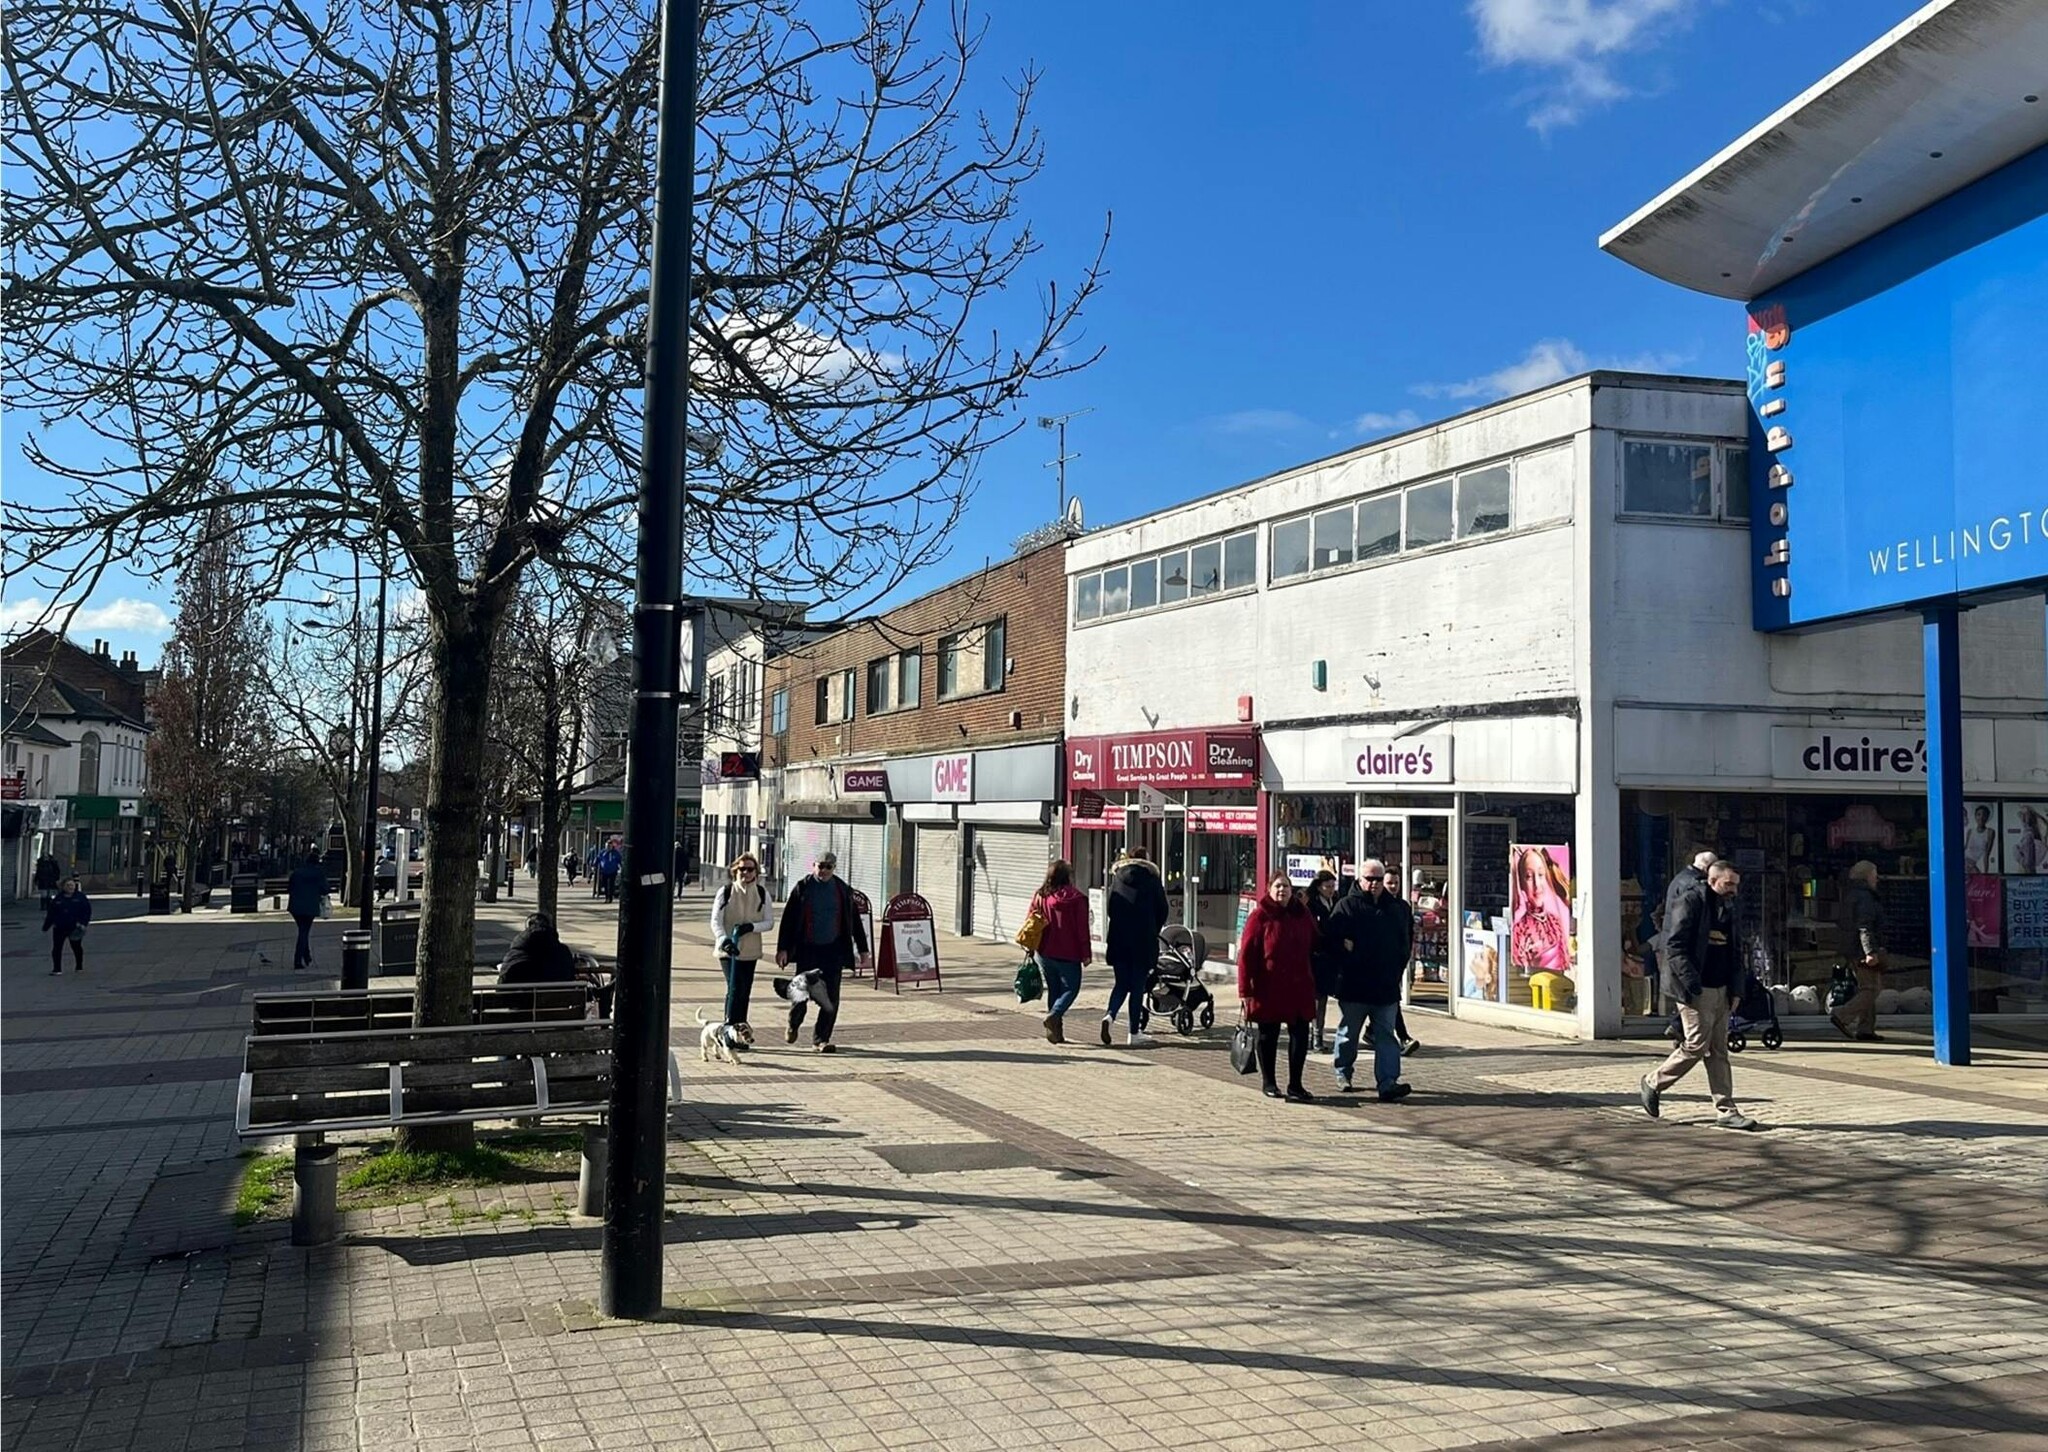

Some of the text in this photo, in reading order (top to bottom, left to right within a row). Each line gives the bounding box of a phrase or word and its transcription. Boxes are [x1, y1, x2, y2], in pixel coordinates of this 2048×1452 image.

[1870, 507, 2048, 575] WELLINGT
[1111, 741, 1193, 770] TIMPSON
[1210, 743, 1235, 760] Dry
[1075, 750, 1092, 773] Dry
[1209, 755, 1254, 767] Cleaning
[1356, 744, 1433, 775] claire's
[847, 775, 883, 787] GAME
[935, 758, 967, 793] GAME
[1073, 771, 1096, 782] Cleaning
[1289, 858, 1301, 867] GET
[2013, 899, 2038, 910] BUY
[2013, 912, 2039, 924] GET
[2013, 926, 2048, 938] FREE
